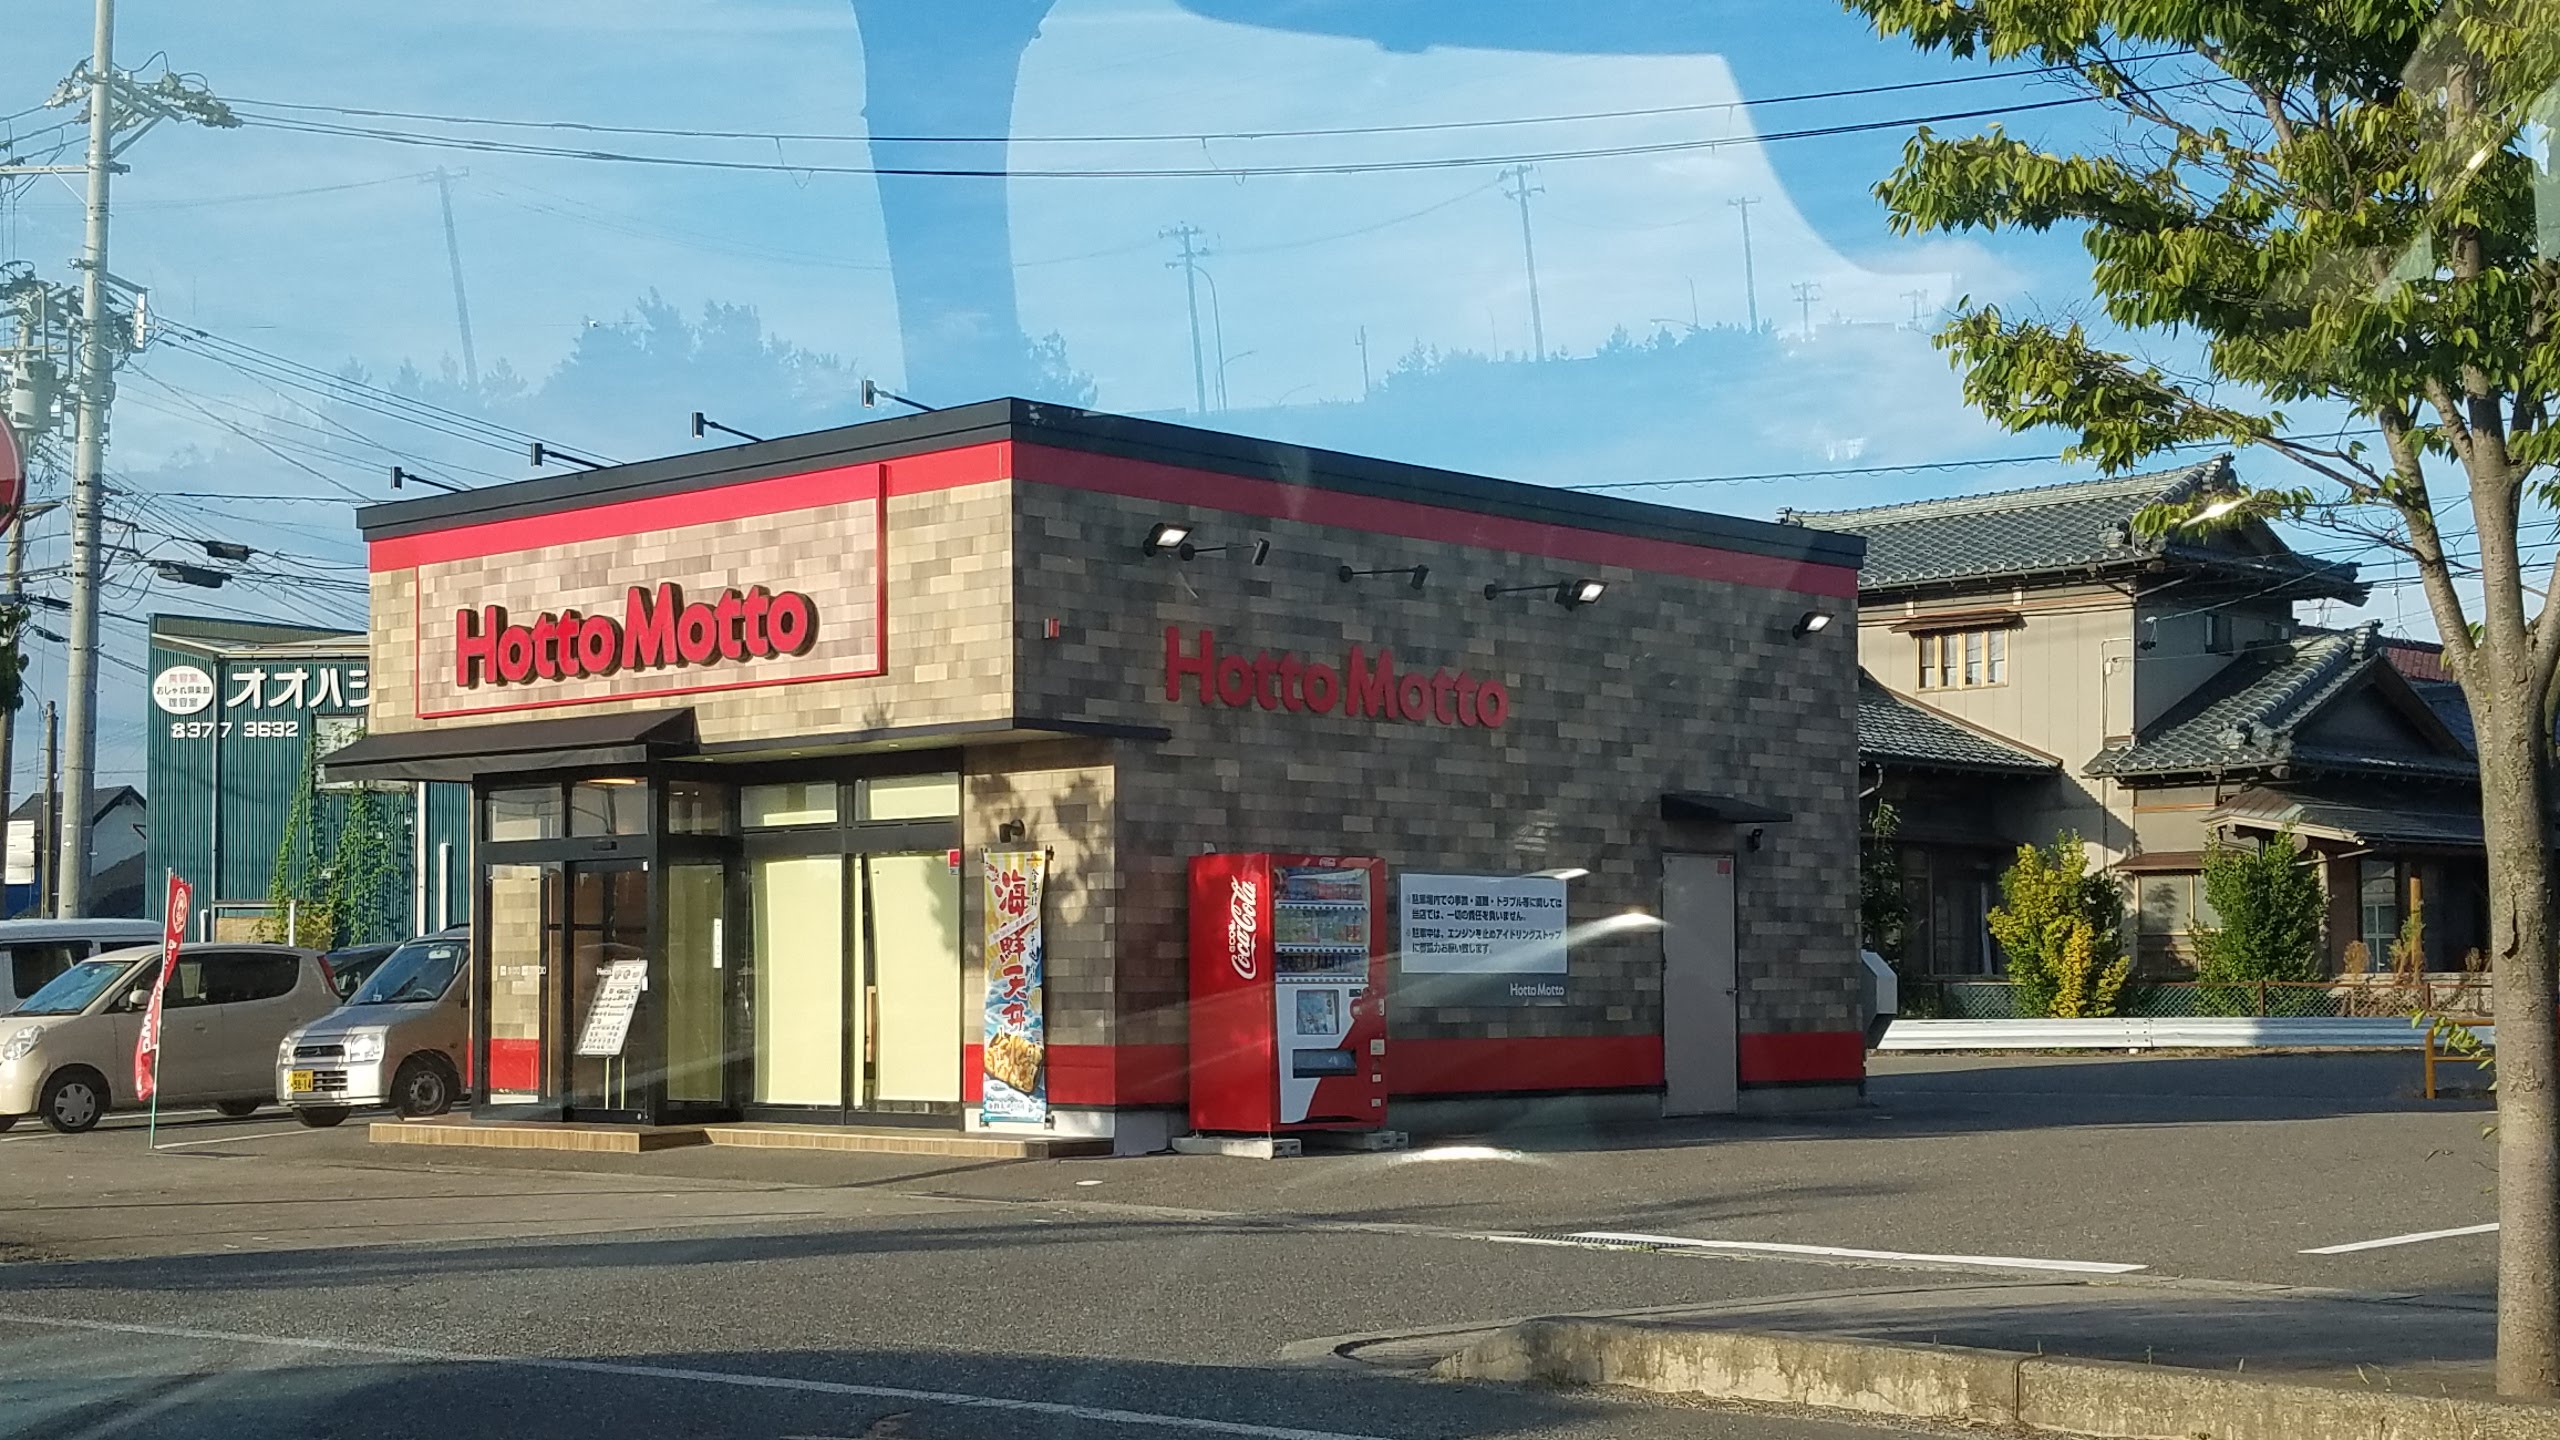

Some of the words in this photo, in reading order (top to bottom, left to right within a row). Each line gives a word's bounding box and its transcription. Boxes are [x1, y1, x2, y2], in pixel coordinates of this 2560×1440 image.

[455, 604, 620, 688] Hotto
[622, 582, 818, 670] Motto
[1165, 626, 1339, 713] Hotto
[1345, 645, 1509, 728] Motto
[244, 721, 298, 737] 3632
[1509, 983, 1537, 997] Hotto
[1537, 983, 1565, 997] Motto
